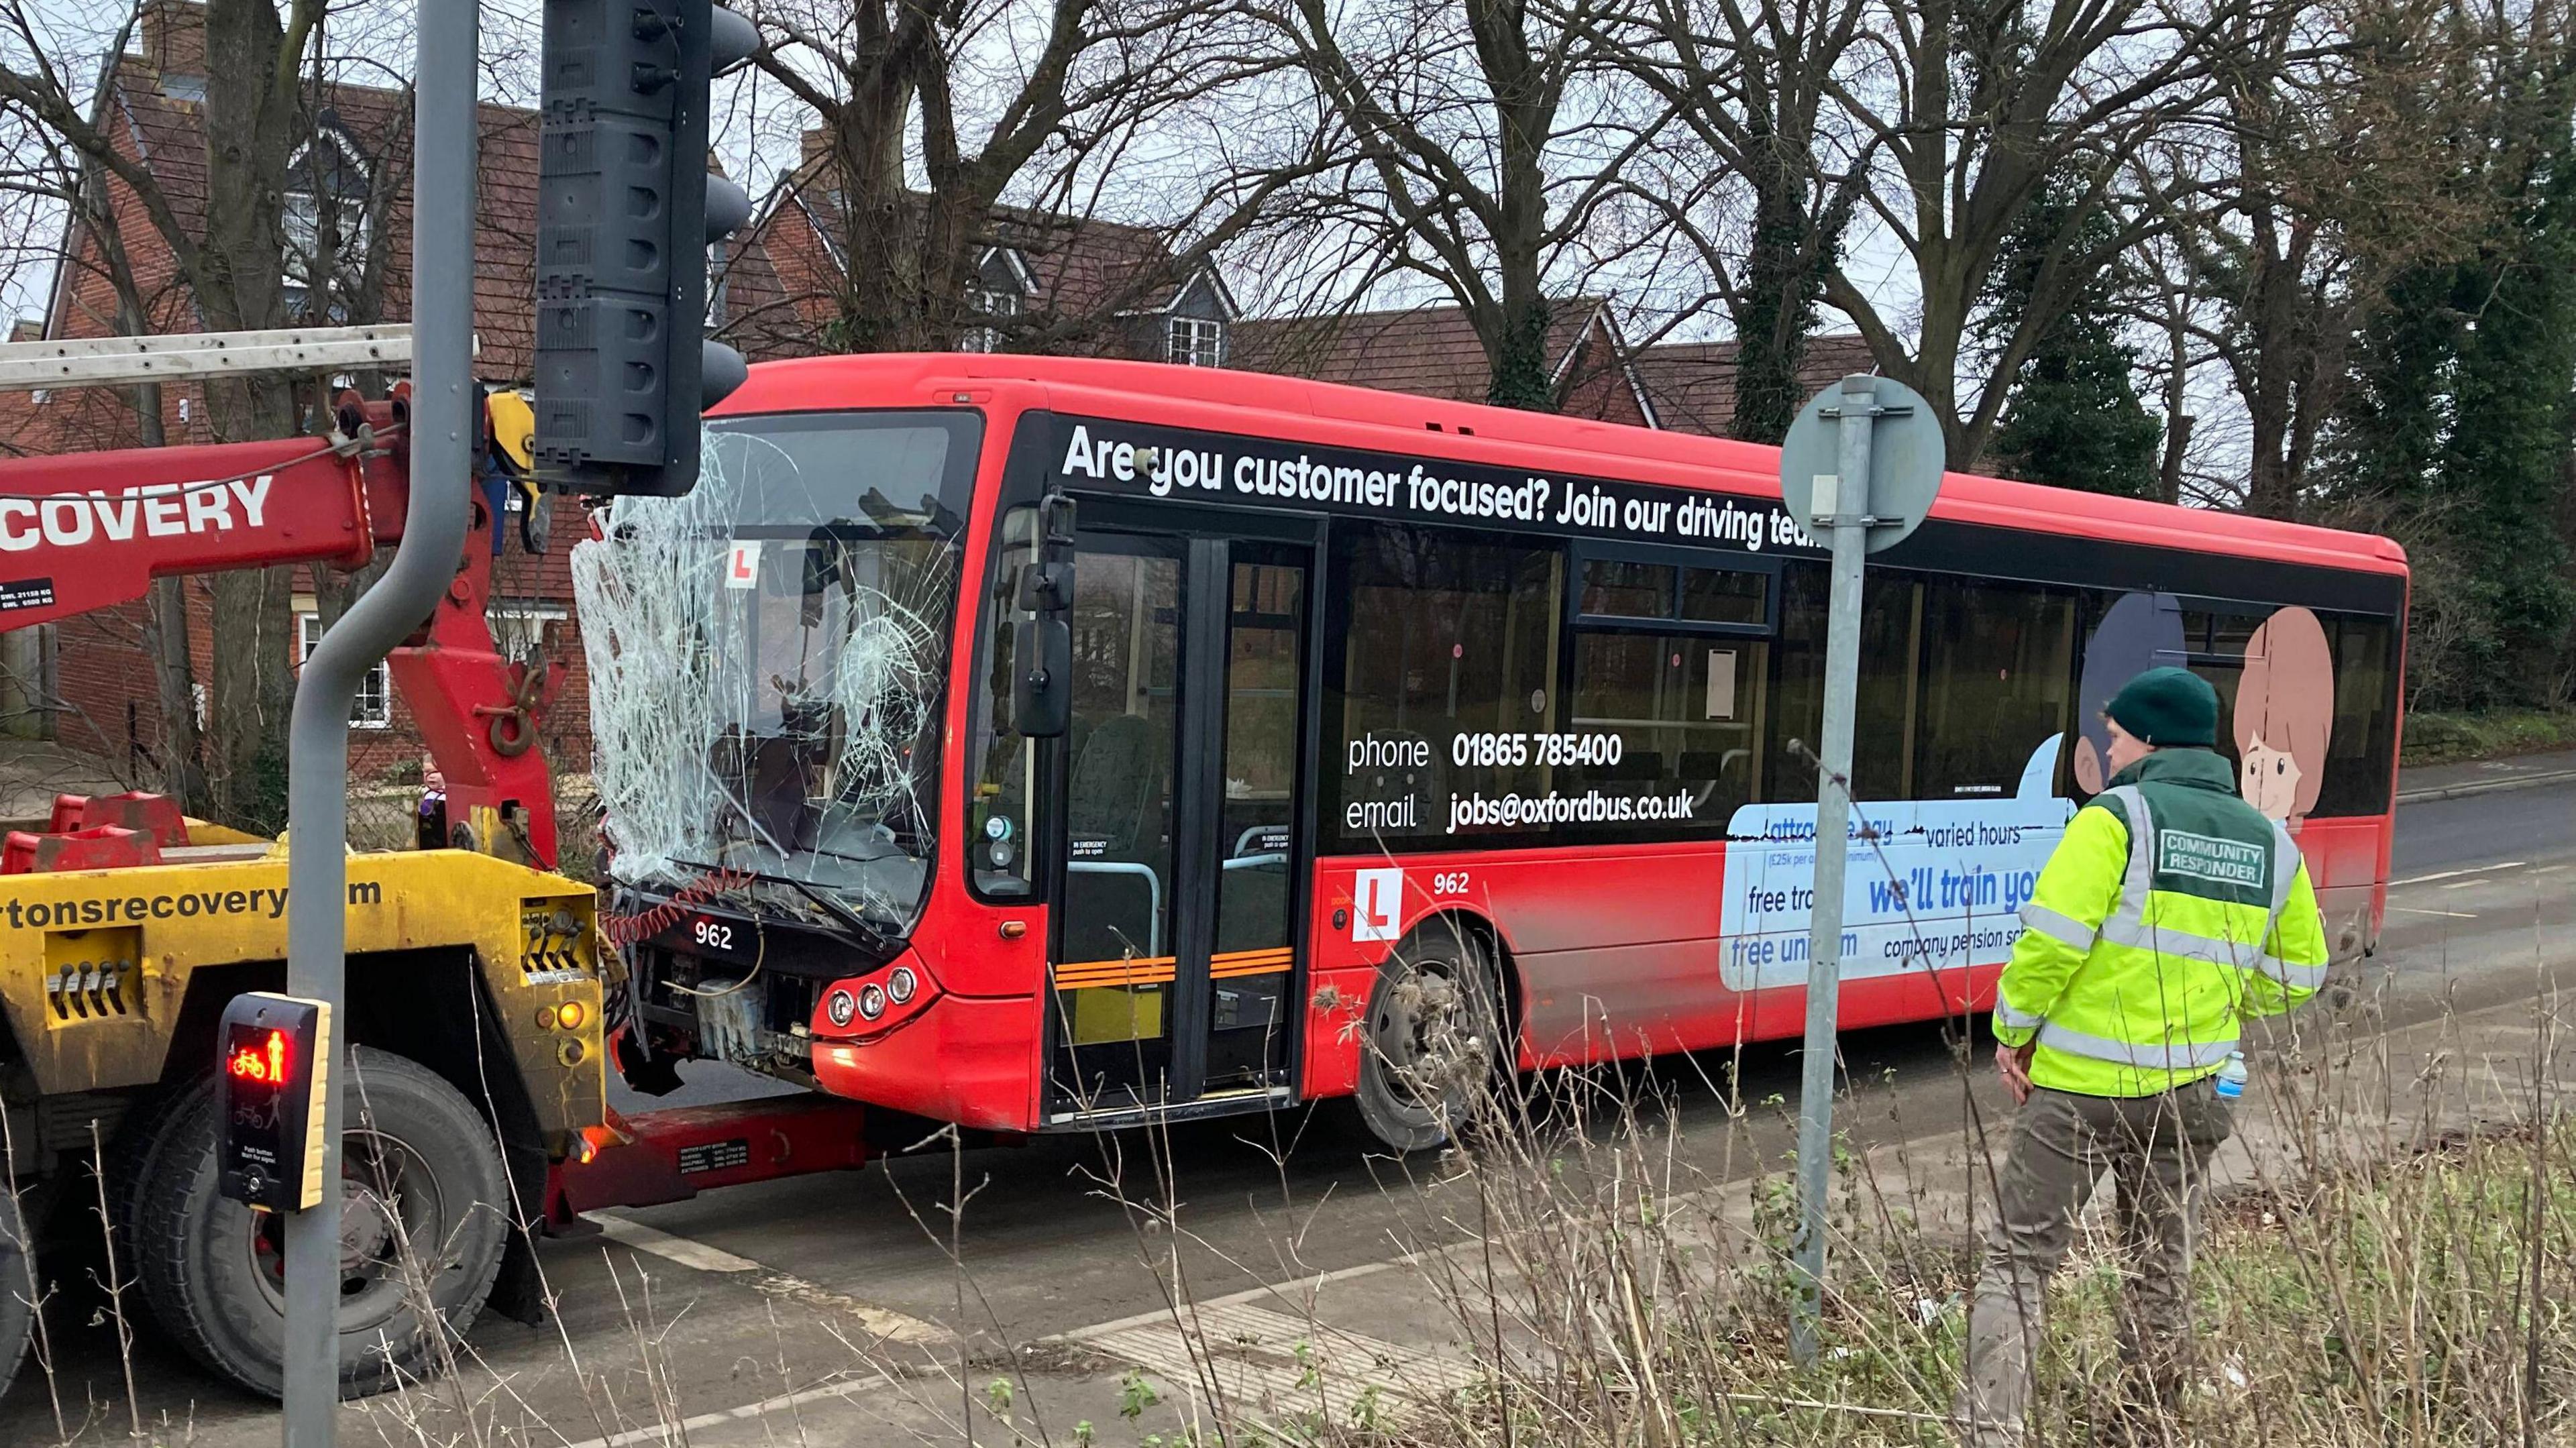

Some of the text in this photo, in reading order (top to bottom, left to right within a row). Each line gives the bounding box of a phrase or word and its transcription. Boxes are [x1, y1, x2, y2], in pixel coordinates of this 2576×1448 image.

[1061, 425, 1135, 482] Are
[1148, 446, 1223, 497] you
[1234, 455, 1401, 508] customer
[1407, 464, 1550, 522] focused?
[1556, 484, 1616, 528] Join
[1623, 500, 1671, 534] our
[1676, 495, 1763, 552] driving
[735, 549, 751, 578] L
[1348, 732, 1622, 775] phone 01865 785400
[1346, 788, 1695, 834] email jobs@oxfordbus.co.uk
[1925, 820, 2021, 848] varied hours
[1769, 853, 1790, 868] (£25k
[1793, 854, 1808, 868] per
[2166, 835, 2261, 865] COMMUNITY
[2169, 852, 2256, 881] RESPONDER
[1434, 872, 1470, 895] 962
[1941, 864, 1996, 909] train
[2004, 871, 2041, 913] yo
[1367, 879, 1389, 927] L
[1749, 886, 1786, 913] free
[695, 921, 733, 950] 962
[1884, 937, 1947, 960] company
[1950, 927, 2002, 957] pension
[1732, 938, 1774, 966] free
